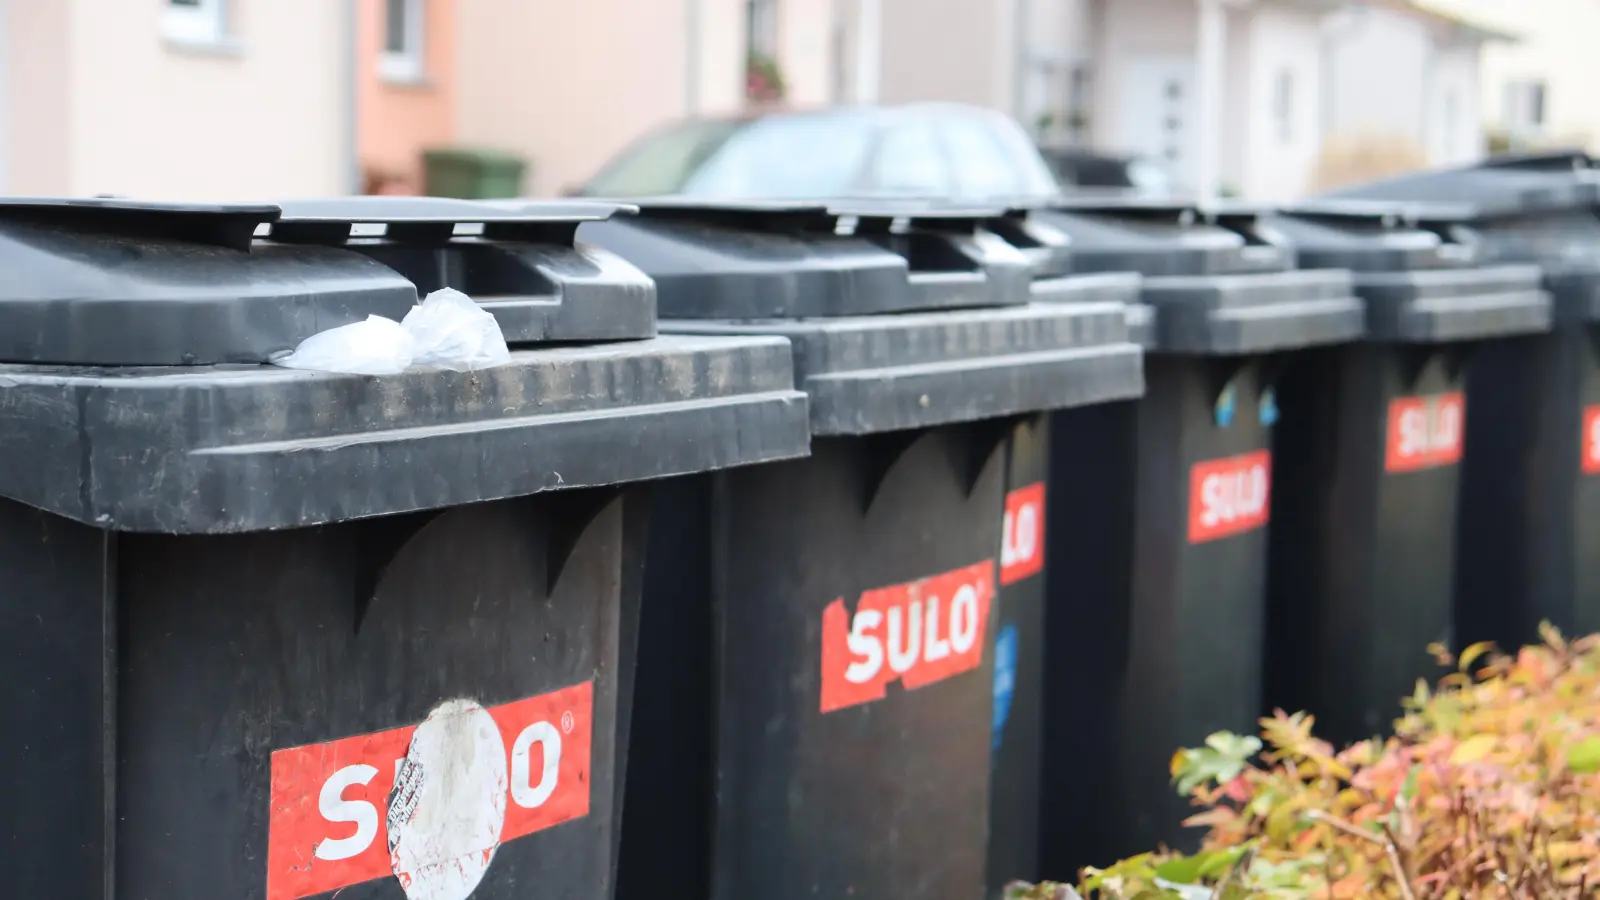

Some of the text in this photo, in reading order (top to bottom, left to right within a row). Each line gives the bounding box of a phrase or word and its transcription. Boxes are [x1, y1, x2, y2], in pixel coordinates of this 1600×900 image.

[1198, 463, 1268, 528] SULO
[844, 583, 978, 684] SULO
[315, 720, 562, 861] SO
